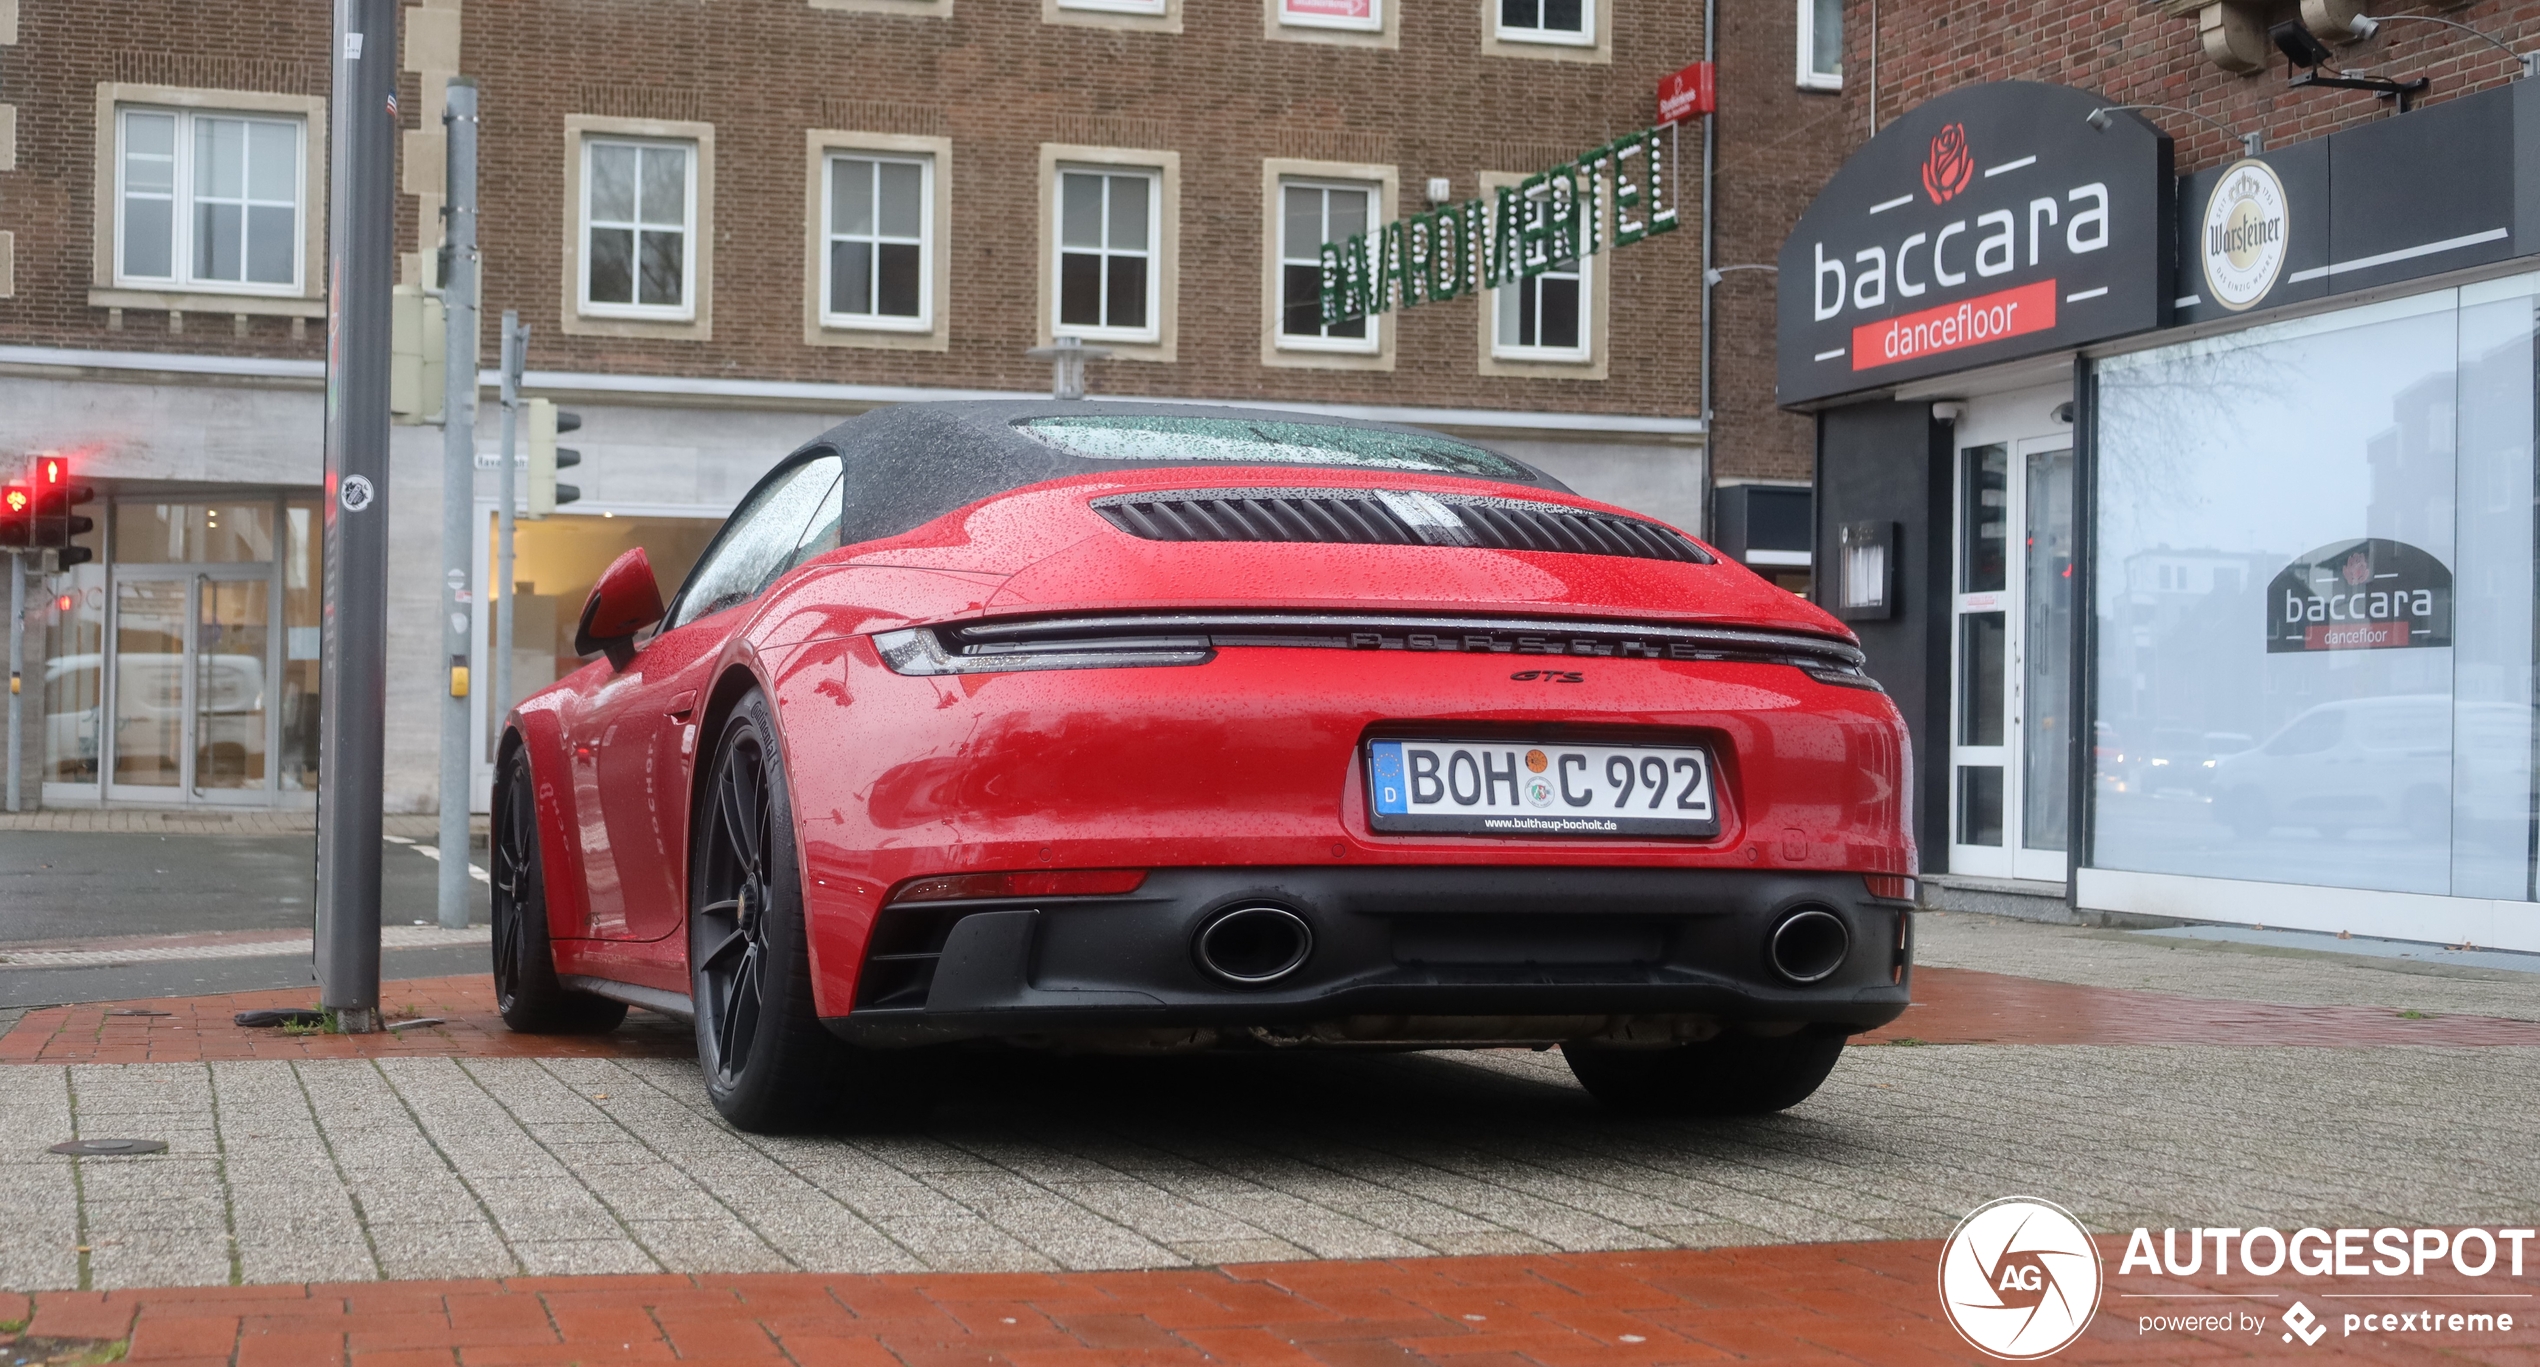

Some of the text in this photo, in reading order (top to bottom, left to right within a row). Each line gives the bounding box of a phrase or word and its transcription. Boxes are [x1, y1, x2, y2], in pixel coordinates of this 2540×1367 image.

[2216, 186, 2274, 219] SEIT 1753
[1815, 182, 2109, 322] baccara
[2210, 213, 2281, 257] Warsteiner
[2216, 253, 2273, 292] DAS EINZIG WAHRE
[1884, 302, 2018, 359] dancefloor
[2286, 589, 2432, 623] baccara
[1350, 632, 1699, 659] PORSCHE
[2324, 628, 2388, 645] dancefloor
[1510, 670, 1585, 683] GTS
[751, 701, 778, 762] Continental
[1384, 786, 1397, 803] D
[1408, 749, 1520, 806] BOH
[1558, 754, 1593, 807] C
[1605, 755, 1706, 810] 992
[1485, 817, 1617, 832] www.bulthaup-bocholt.de
